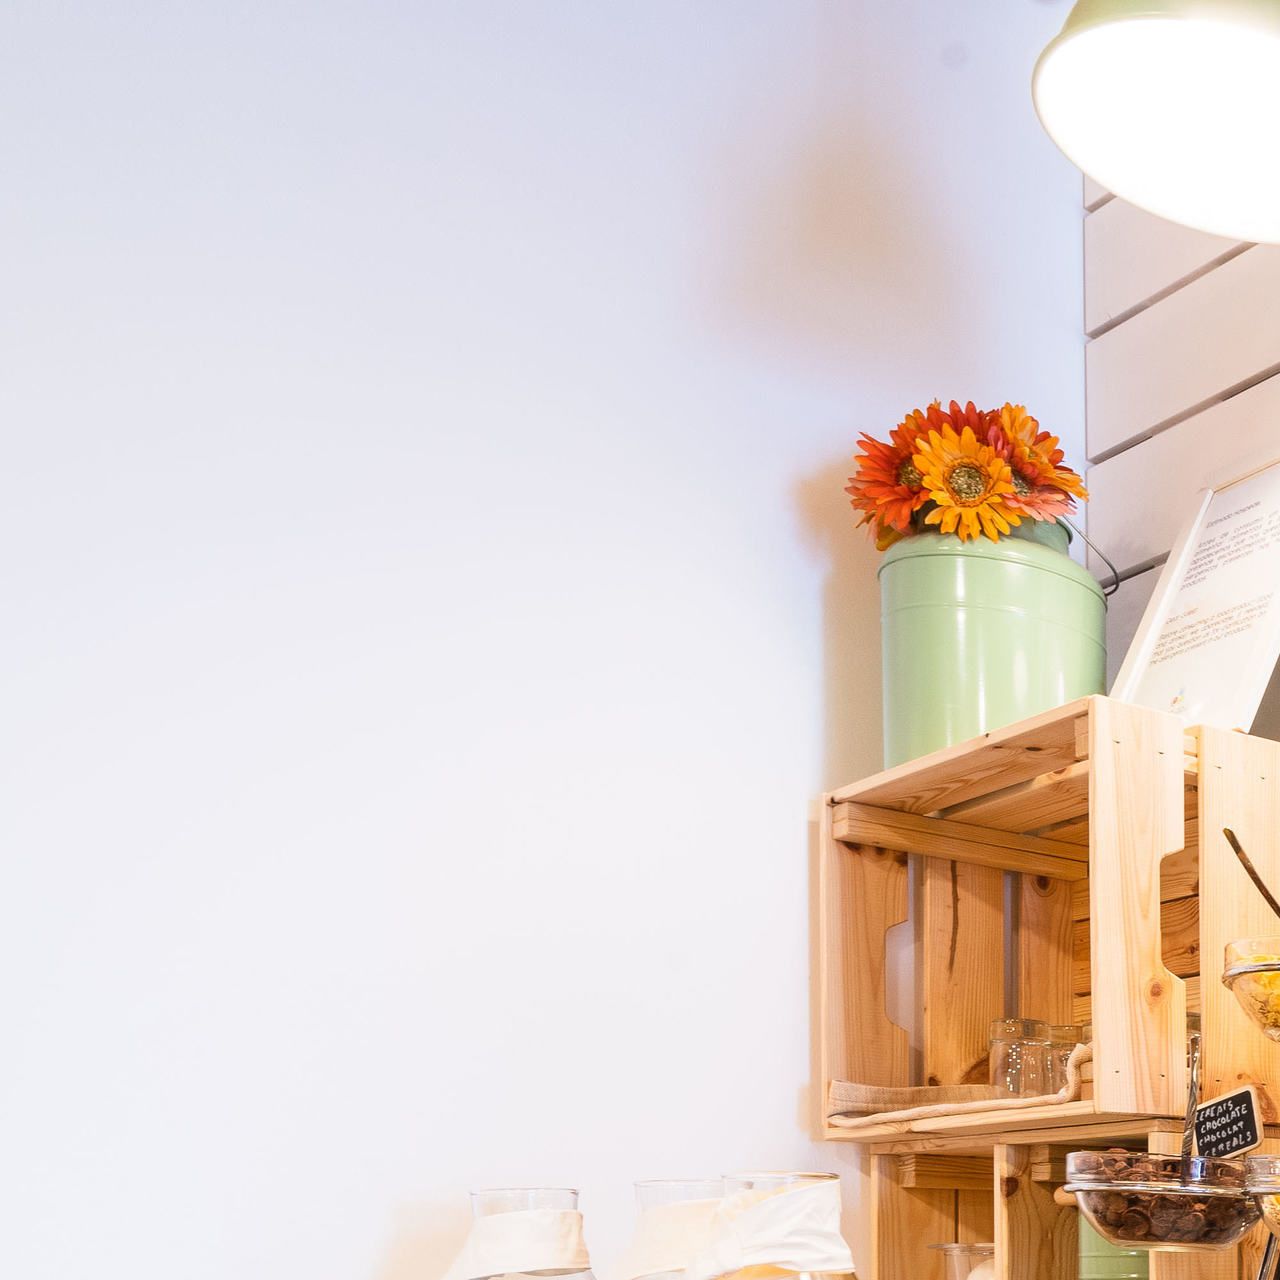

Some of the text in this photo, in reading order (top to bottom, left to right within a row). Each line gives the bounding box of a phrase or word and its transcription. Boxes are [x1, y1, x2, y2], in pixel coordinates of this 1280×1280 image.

[1201, 1104, 1248, 1133] CHOCOLATE
[1199, 1121, 1244, 1146] CHOCOLAT
[1205, 1131, 1252, 1157] CEREALS
